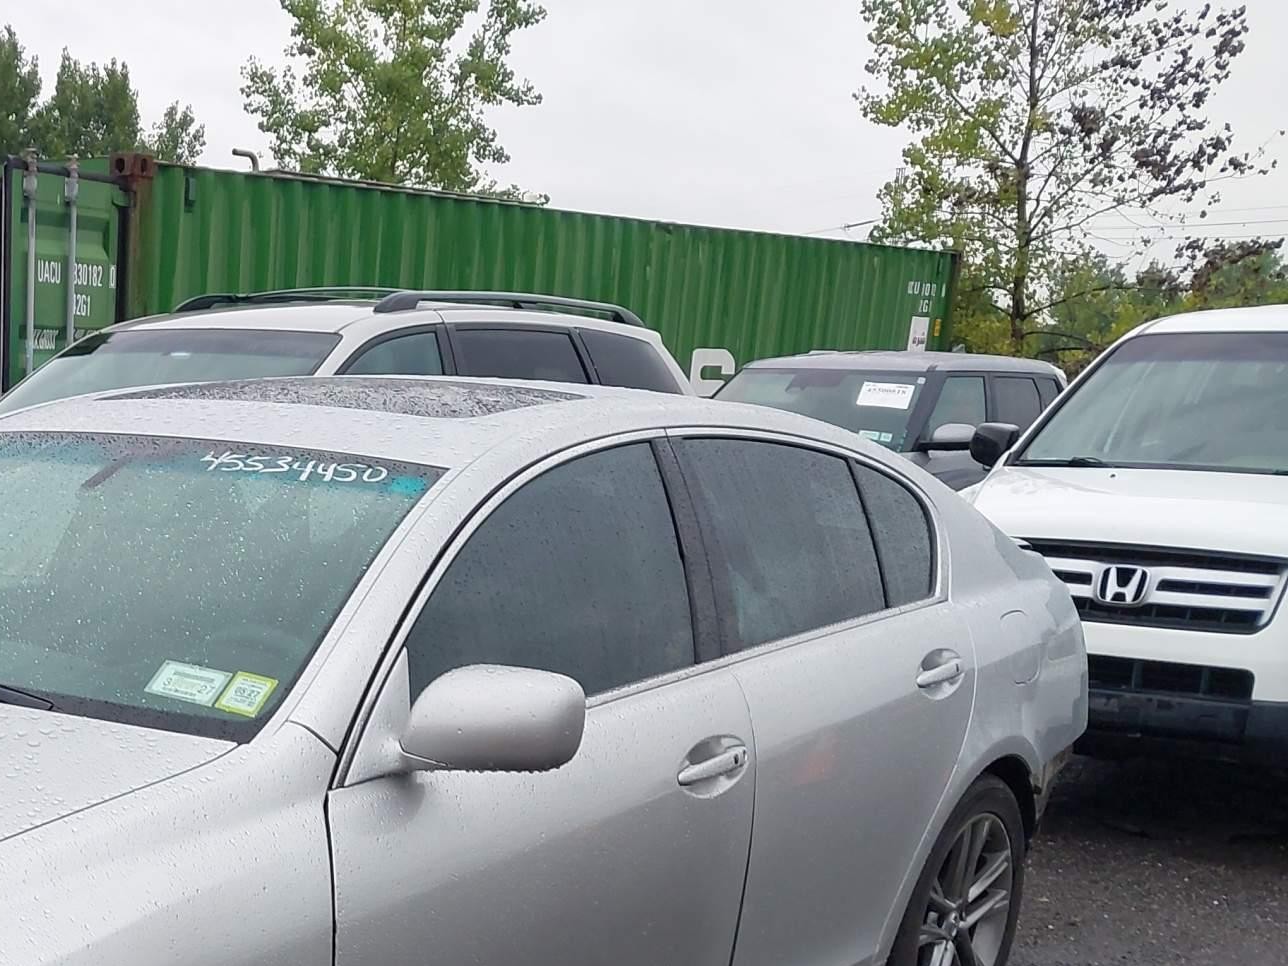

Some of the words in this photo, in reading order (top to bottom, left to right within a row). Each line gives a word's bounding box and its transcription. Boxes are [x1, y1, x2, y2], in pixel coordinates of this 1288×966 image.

[37, 259, 61, 284] UACU
[73, 294, 91, 317] 2G1
[200, 451, 388, 482] 45534450
